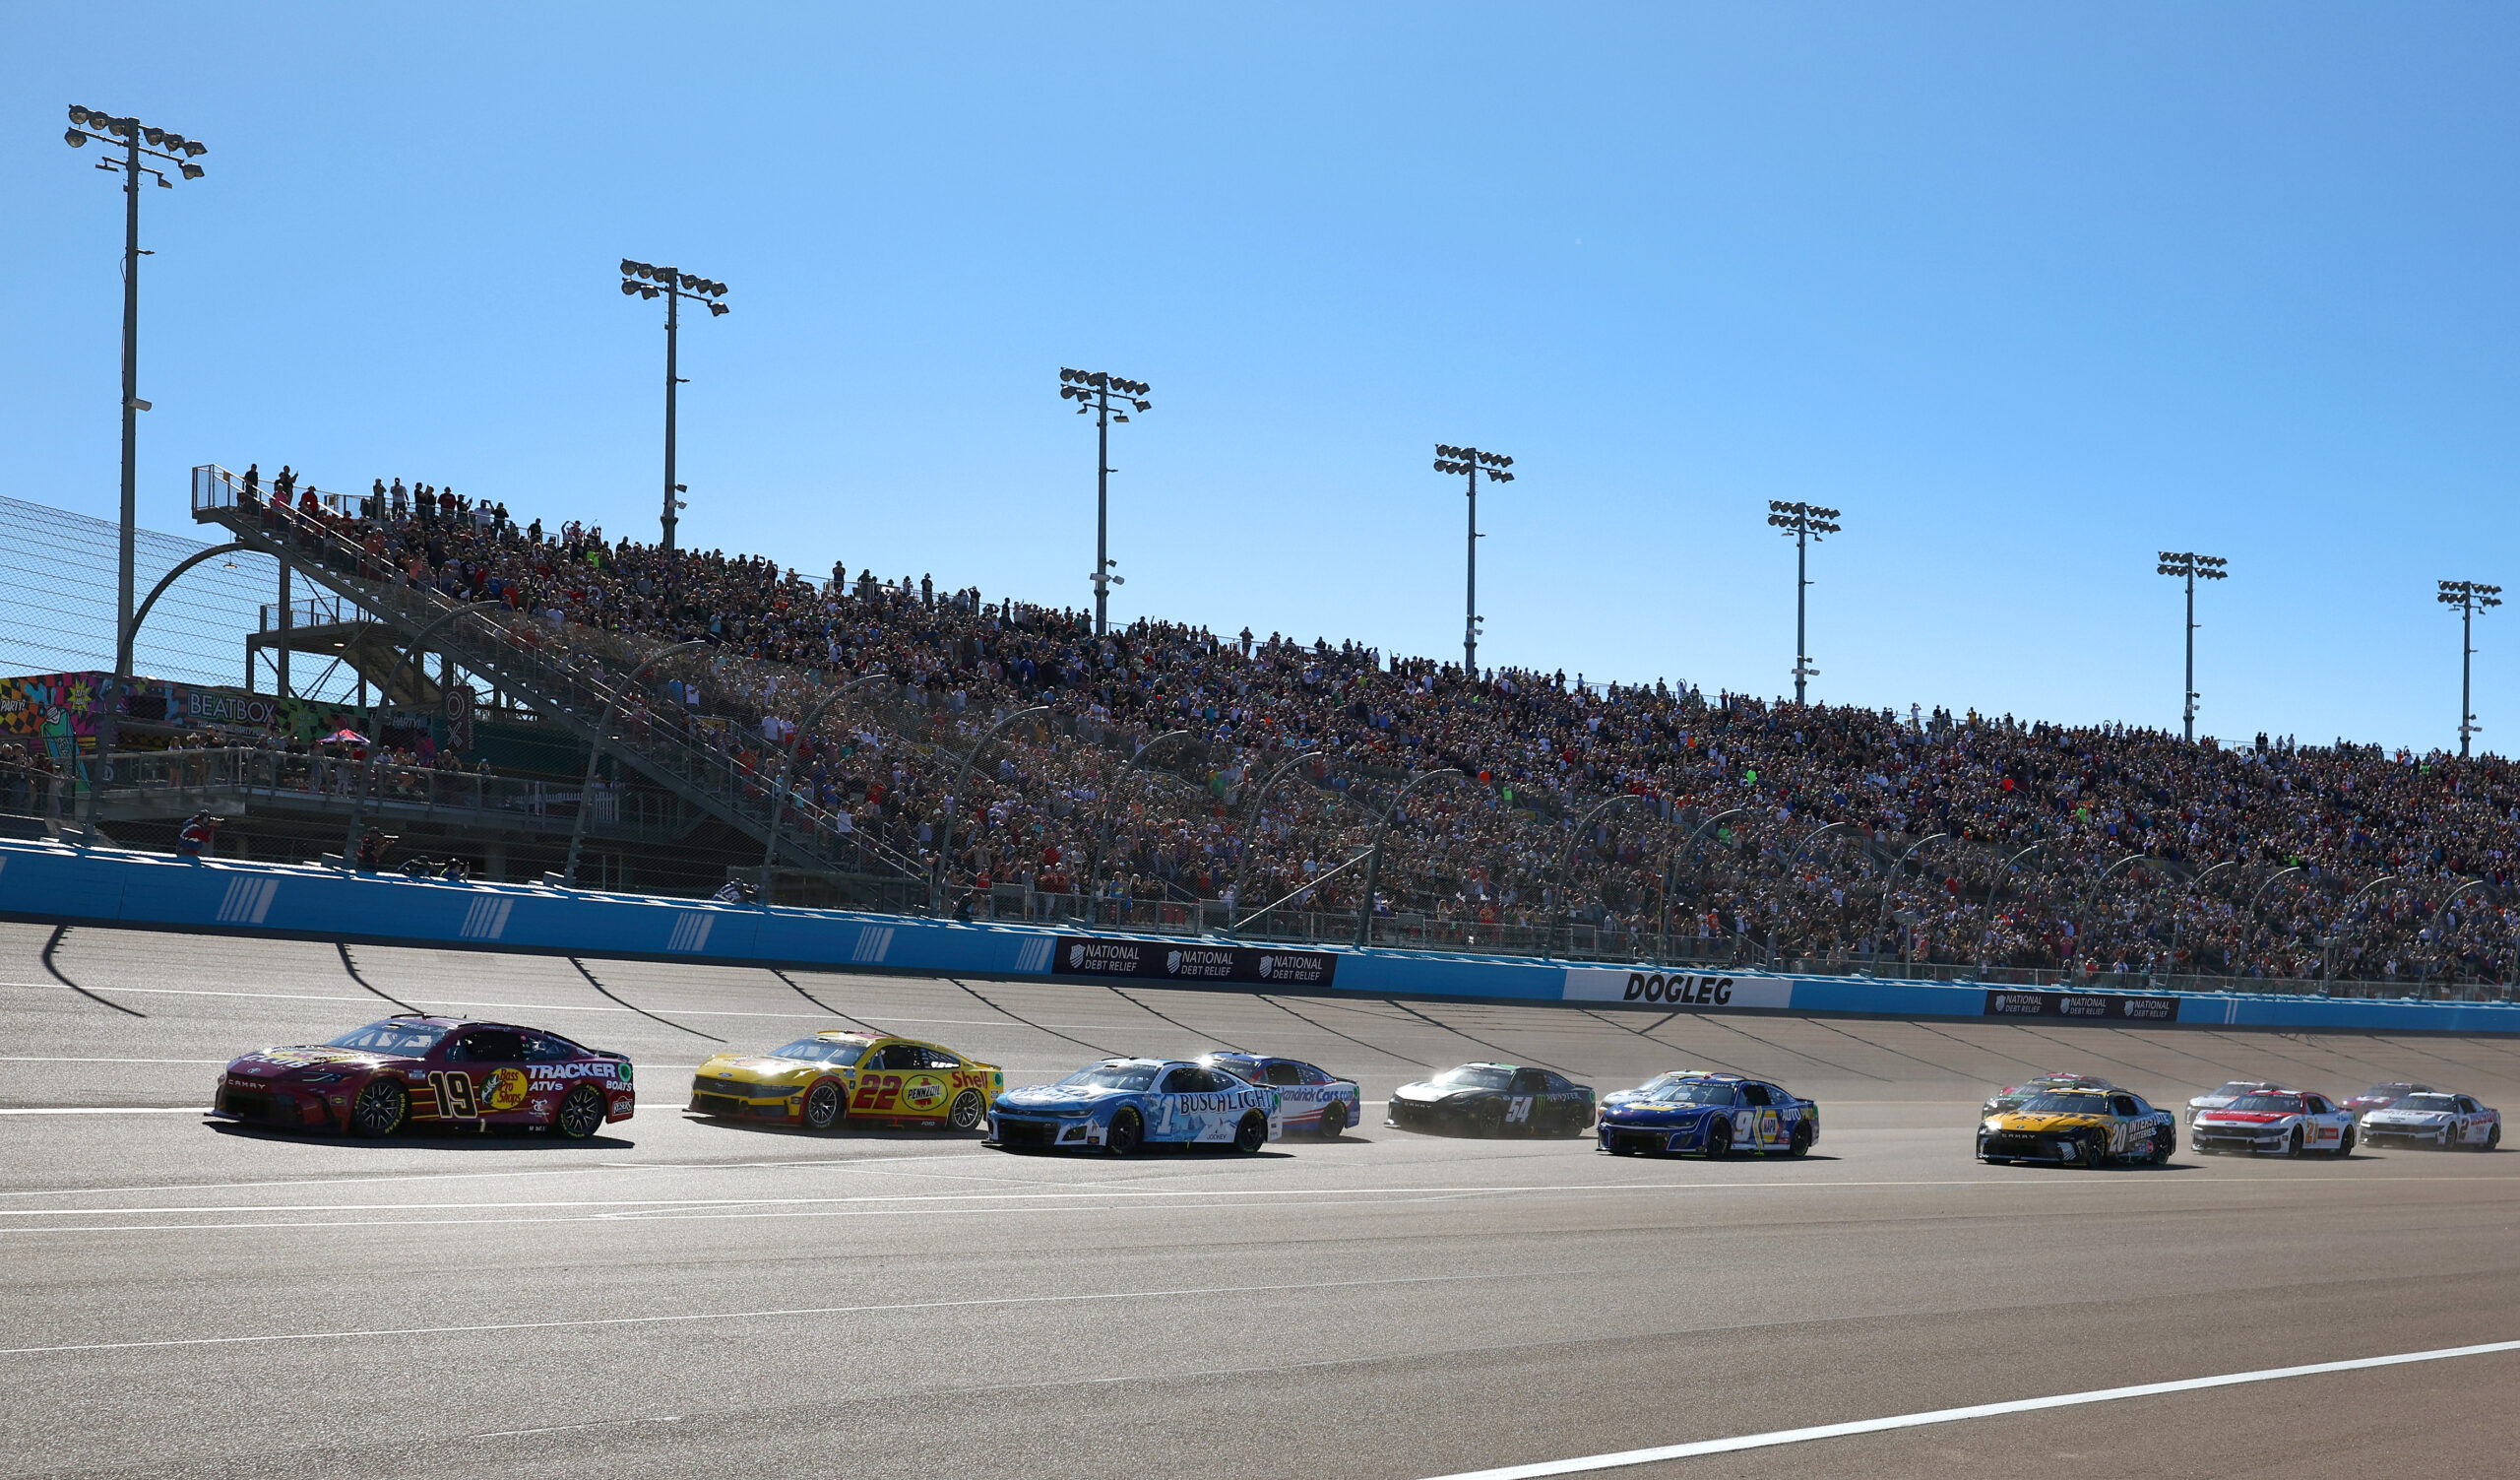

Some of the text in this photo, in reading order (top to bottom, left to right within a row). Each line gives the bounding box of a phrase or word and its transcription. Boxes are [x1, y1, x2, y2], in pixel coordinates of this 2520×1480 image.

[190, 693, 275, 723] BEATBOX
[1086, 944, 1140, 960] NATIONAL
[1182, 950, 1233, 965] NATIONAL
[1085, 959, 1137, 972] DEBT RELIEF
[1274, 955, 1323, 970] NATIONAL
[1181, 965, 1231, 977] DEBT RELIEF
[1273, 969, 1321, 981] DEBT RELIEF
[1623, 973, 1733, 1004] DOGLEG
[2005, 995, 2043, 1005] NATIONAL
[2070, 997, 2107, 1007] NATIONAL
[2134, 999, 2170, 1010] NATIONAL
[242, 1056, 310, 1068] CLUB
[500, 1068, 519, 1081] Bass
[526, 1063, 616, 1079] TRACKER
[228, 1079, 266, 1090] CAMRY
[499, 1081, 513, 1093] Pro
[529, 1080, 564, 1092] ATVs
[606, 1080, 633, 1092] BOATS
[951, 1070, 988, 1089] Shell
[428, 1071, 477, 1119] 19
[497, 1091, 521, 1104] Shops
[851, 1074, 902, 1110] 22
[908, 1084, 941, 1100] PENNZOIL
[1180, 1093, 1227, 1115] BUSCH
[1228, 1090, 1272, 1110] LIGHT
[1505, 1096, 1534, 1123] 54
[1156, 1094, 1176, 1136] 1
[1782, 1108, 1801, 1121] AUTO
[1734, 1111, 1754, 1141] 9
[2129, 1113, 2169, 1133] INTERSTATE
[2305, 1118, 2319, 1143] 21
[2110, 1124, 2126, 1152] 20
[2129, 1127, 2157, 1142] BATTERIES
